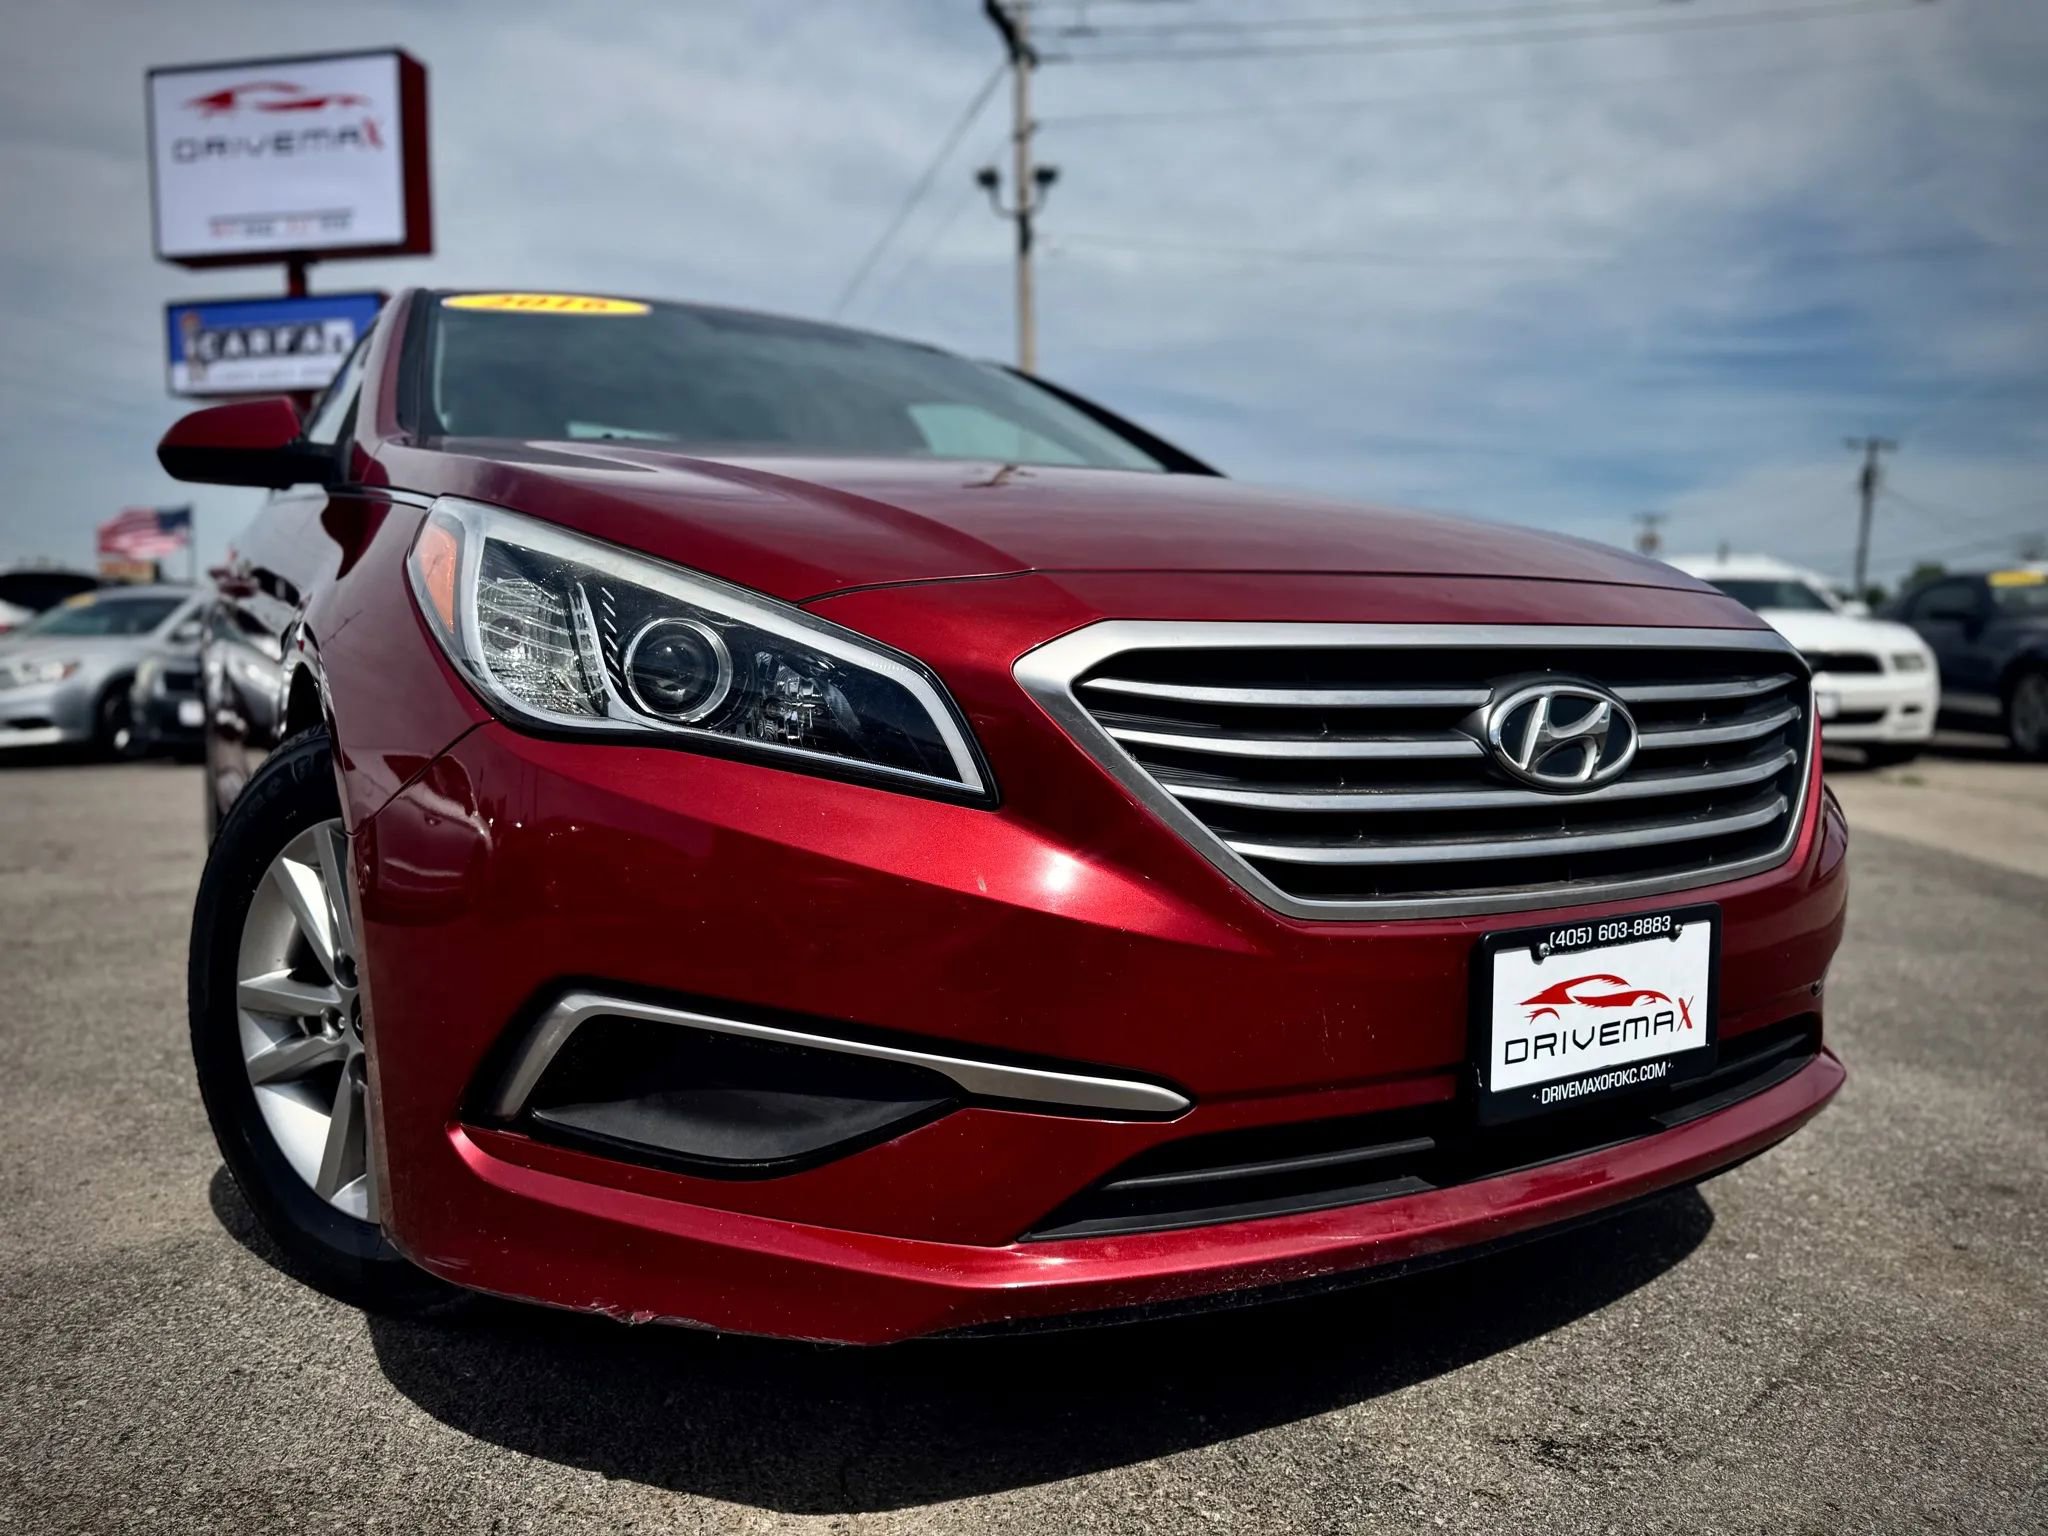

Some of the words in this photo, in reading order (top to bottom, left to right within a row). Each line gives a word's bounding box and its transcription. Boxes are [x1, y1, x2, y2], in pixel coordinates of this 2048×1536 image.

[171, 116, 383, 164] DRIVEMAX
[200, 317, 353, 363] CARFA
[1550, 926, 1593, 949] (405)
[1598, 915, 1671, 941] 603-8883
[1504, 995, 1694, 1065] DRIVEMAX
[1541, 1061, 1667, 1104] DRIVEMAXOFOKC.COM
